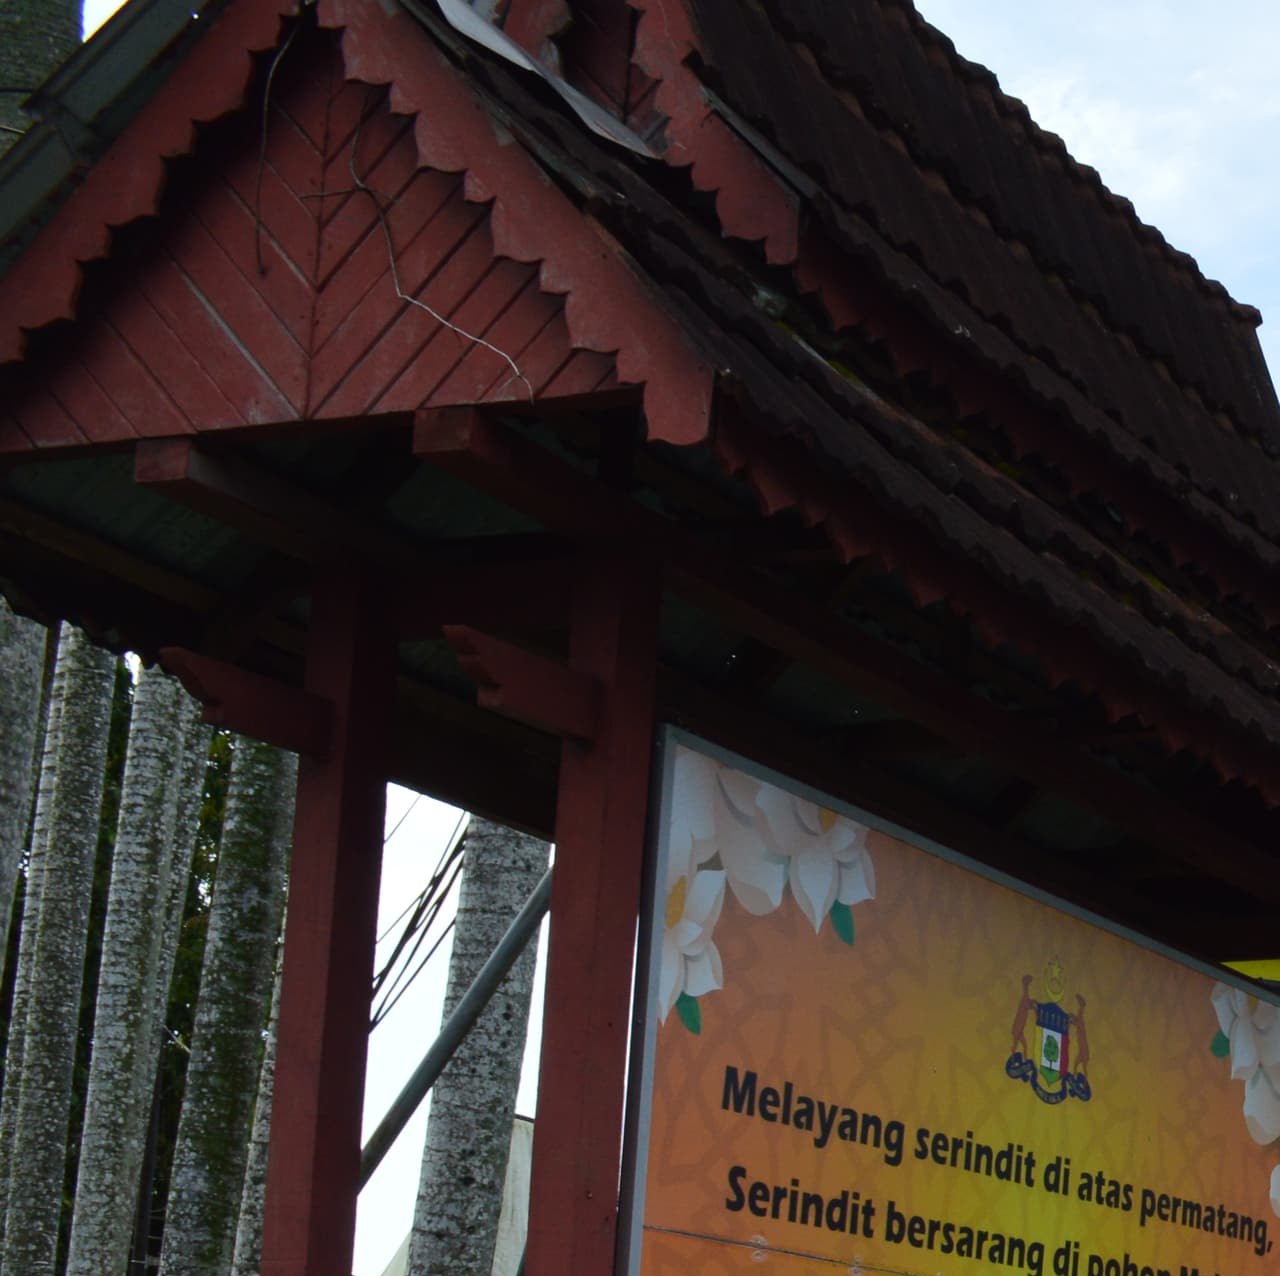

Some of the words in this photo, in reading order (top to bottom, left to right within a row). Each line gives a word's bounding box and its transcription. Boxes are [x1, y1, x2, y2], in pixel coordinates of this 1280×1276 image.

[721, 1065, 905, 1167] Melayang
[914, 1127, 1036, 1188] serindit
[1043, 1155, 1071, 1196] di
[1077, 1170, 1134, 1212] atas
[1139, 1188, 1273, 1257] permatang,
[725, 1165, 875, 1239] Serindit
